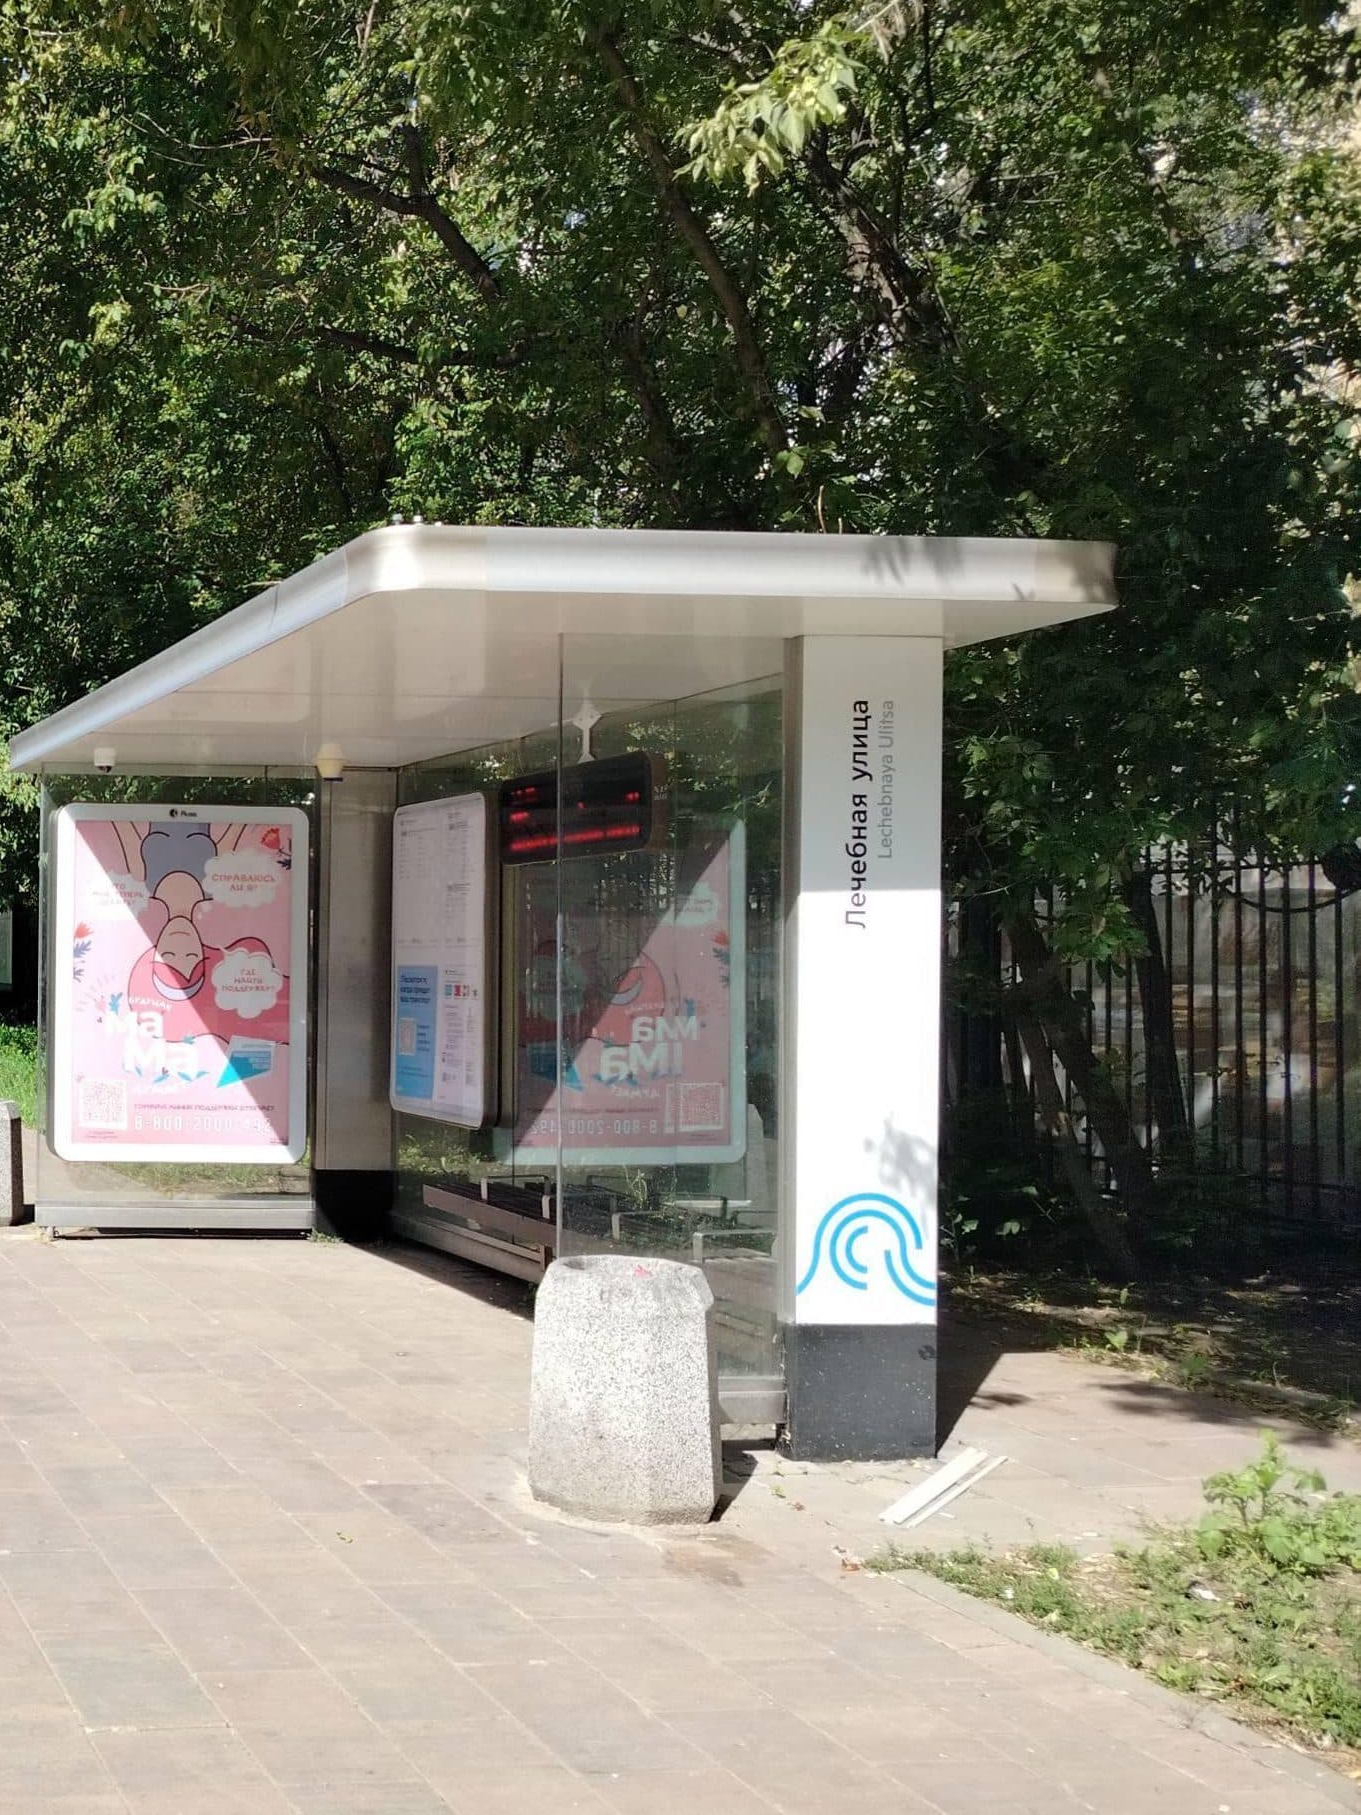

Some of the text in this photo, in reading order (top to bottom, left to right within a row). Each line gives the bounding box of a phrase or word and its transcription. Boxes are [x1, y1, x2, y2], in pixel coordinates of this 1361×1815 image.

[845, 699, 873, 929] Лечебная улица
[877, 699, 897, 859] Lechebnaya Ulitsa
